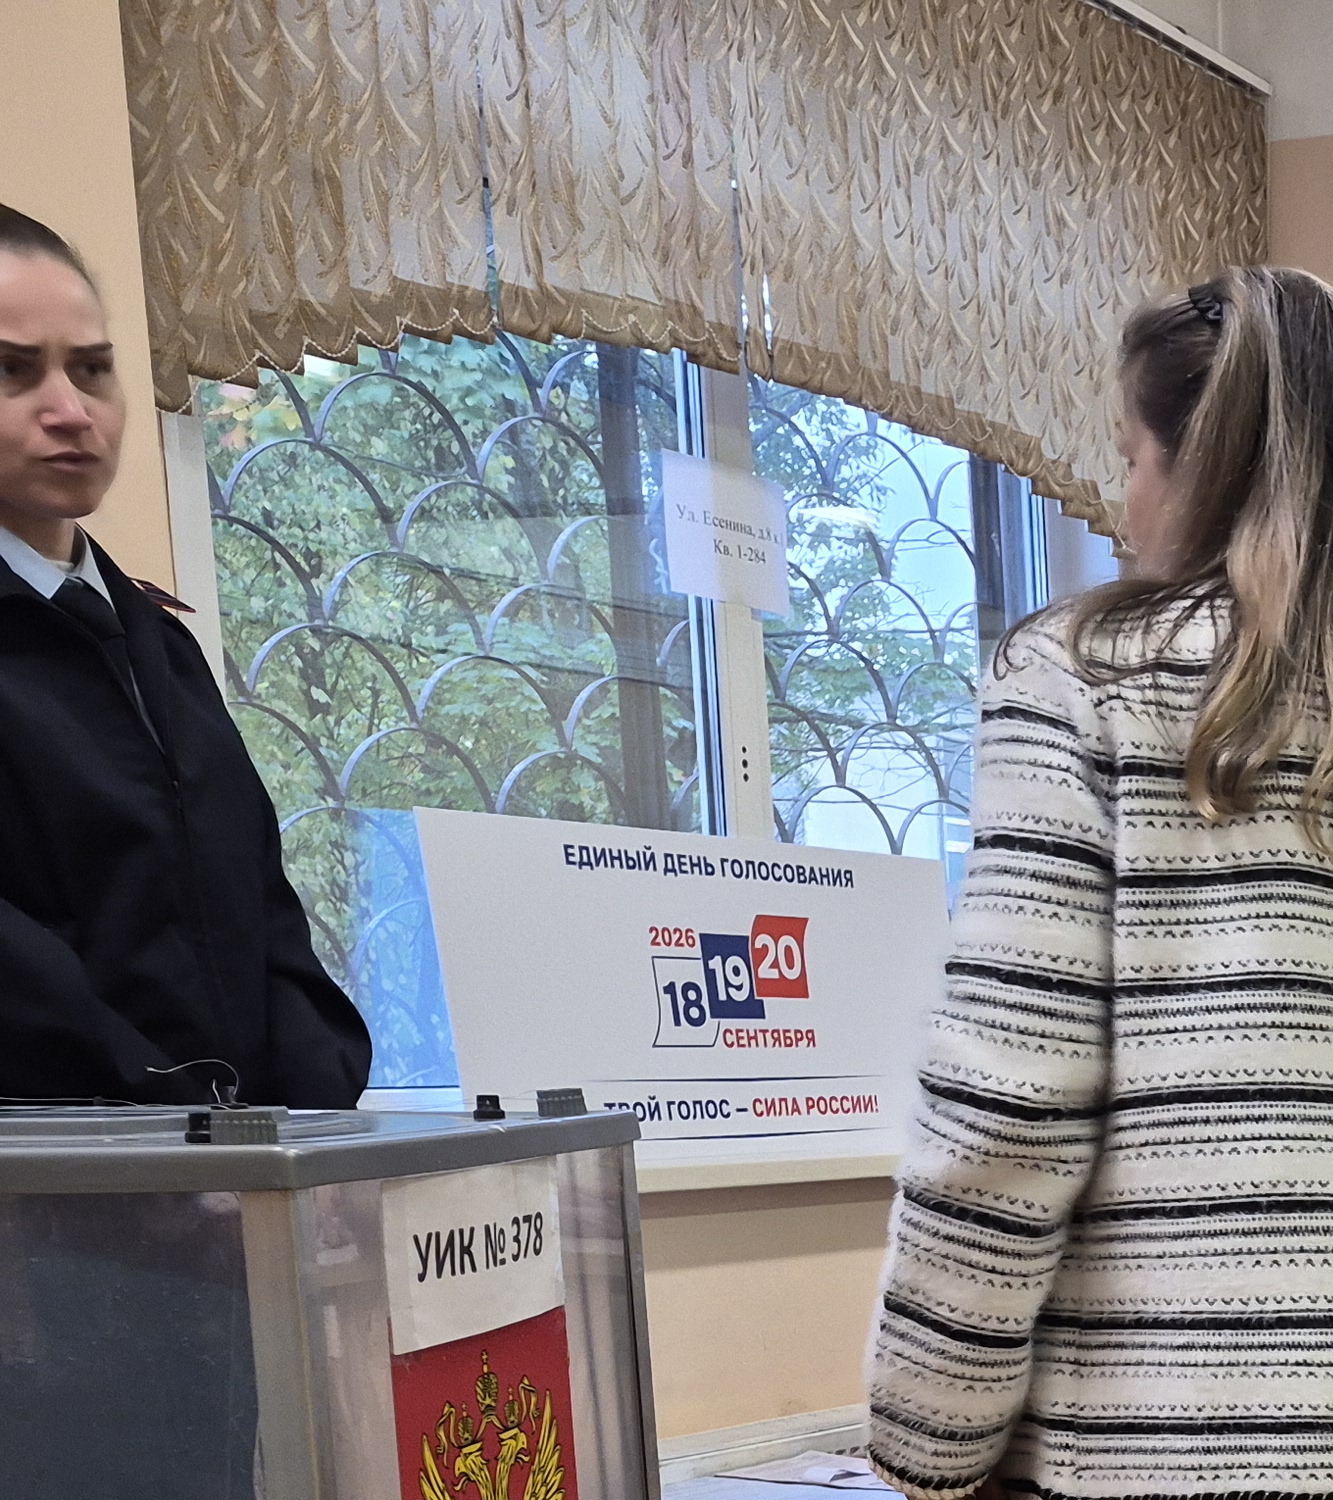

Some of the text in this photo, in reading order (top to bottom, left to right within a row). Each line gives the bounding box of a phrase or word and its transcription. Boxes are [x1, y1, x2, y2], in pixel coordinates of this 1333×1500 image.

[676, 504, 698, 523] Ул.
[703, 510, 755, 538] Есенина,
[713, 539, 766, 564] Кв. 1-284
[562, 843, 855, 888] ЕДИНЫЙ ДЕНЬ ГОЛОСОВАНИЯ
[648, 926, 696, 948] 2026
[754, 933, 802, 980] 20
[708, 955, 751, 1002] 19
[662, 981, 707, 1027] 18
[722, 1028, 817, 1049] СЕНТЯБРЯ
[603, 1095, 662, 1122] ОЙ
[667, 1098, 732, 1121] ГОЛОС
[752, 1096, 801, 1118] СИЛА
[806, 1094, 879, 1116] РОССИИ!
[413, 1211, 543, 1283] УИК № 378
